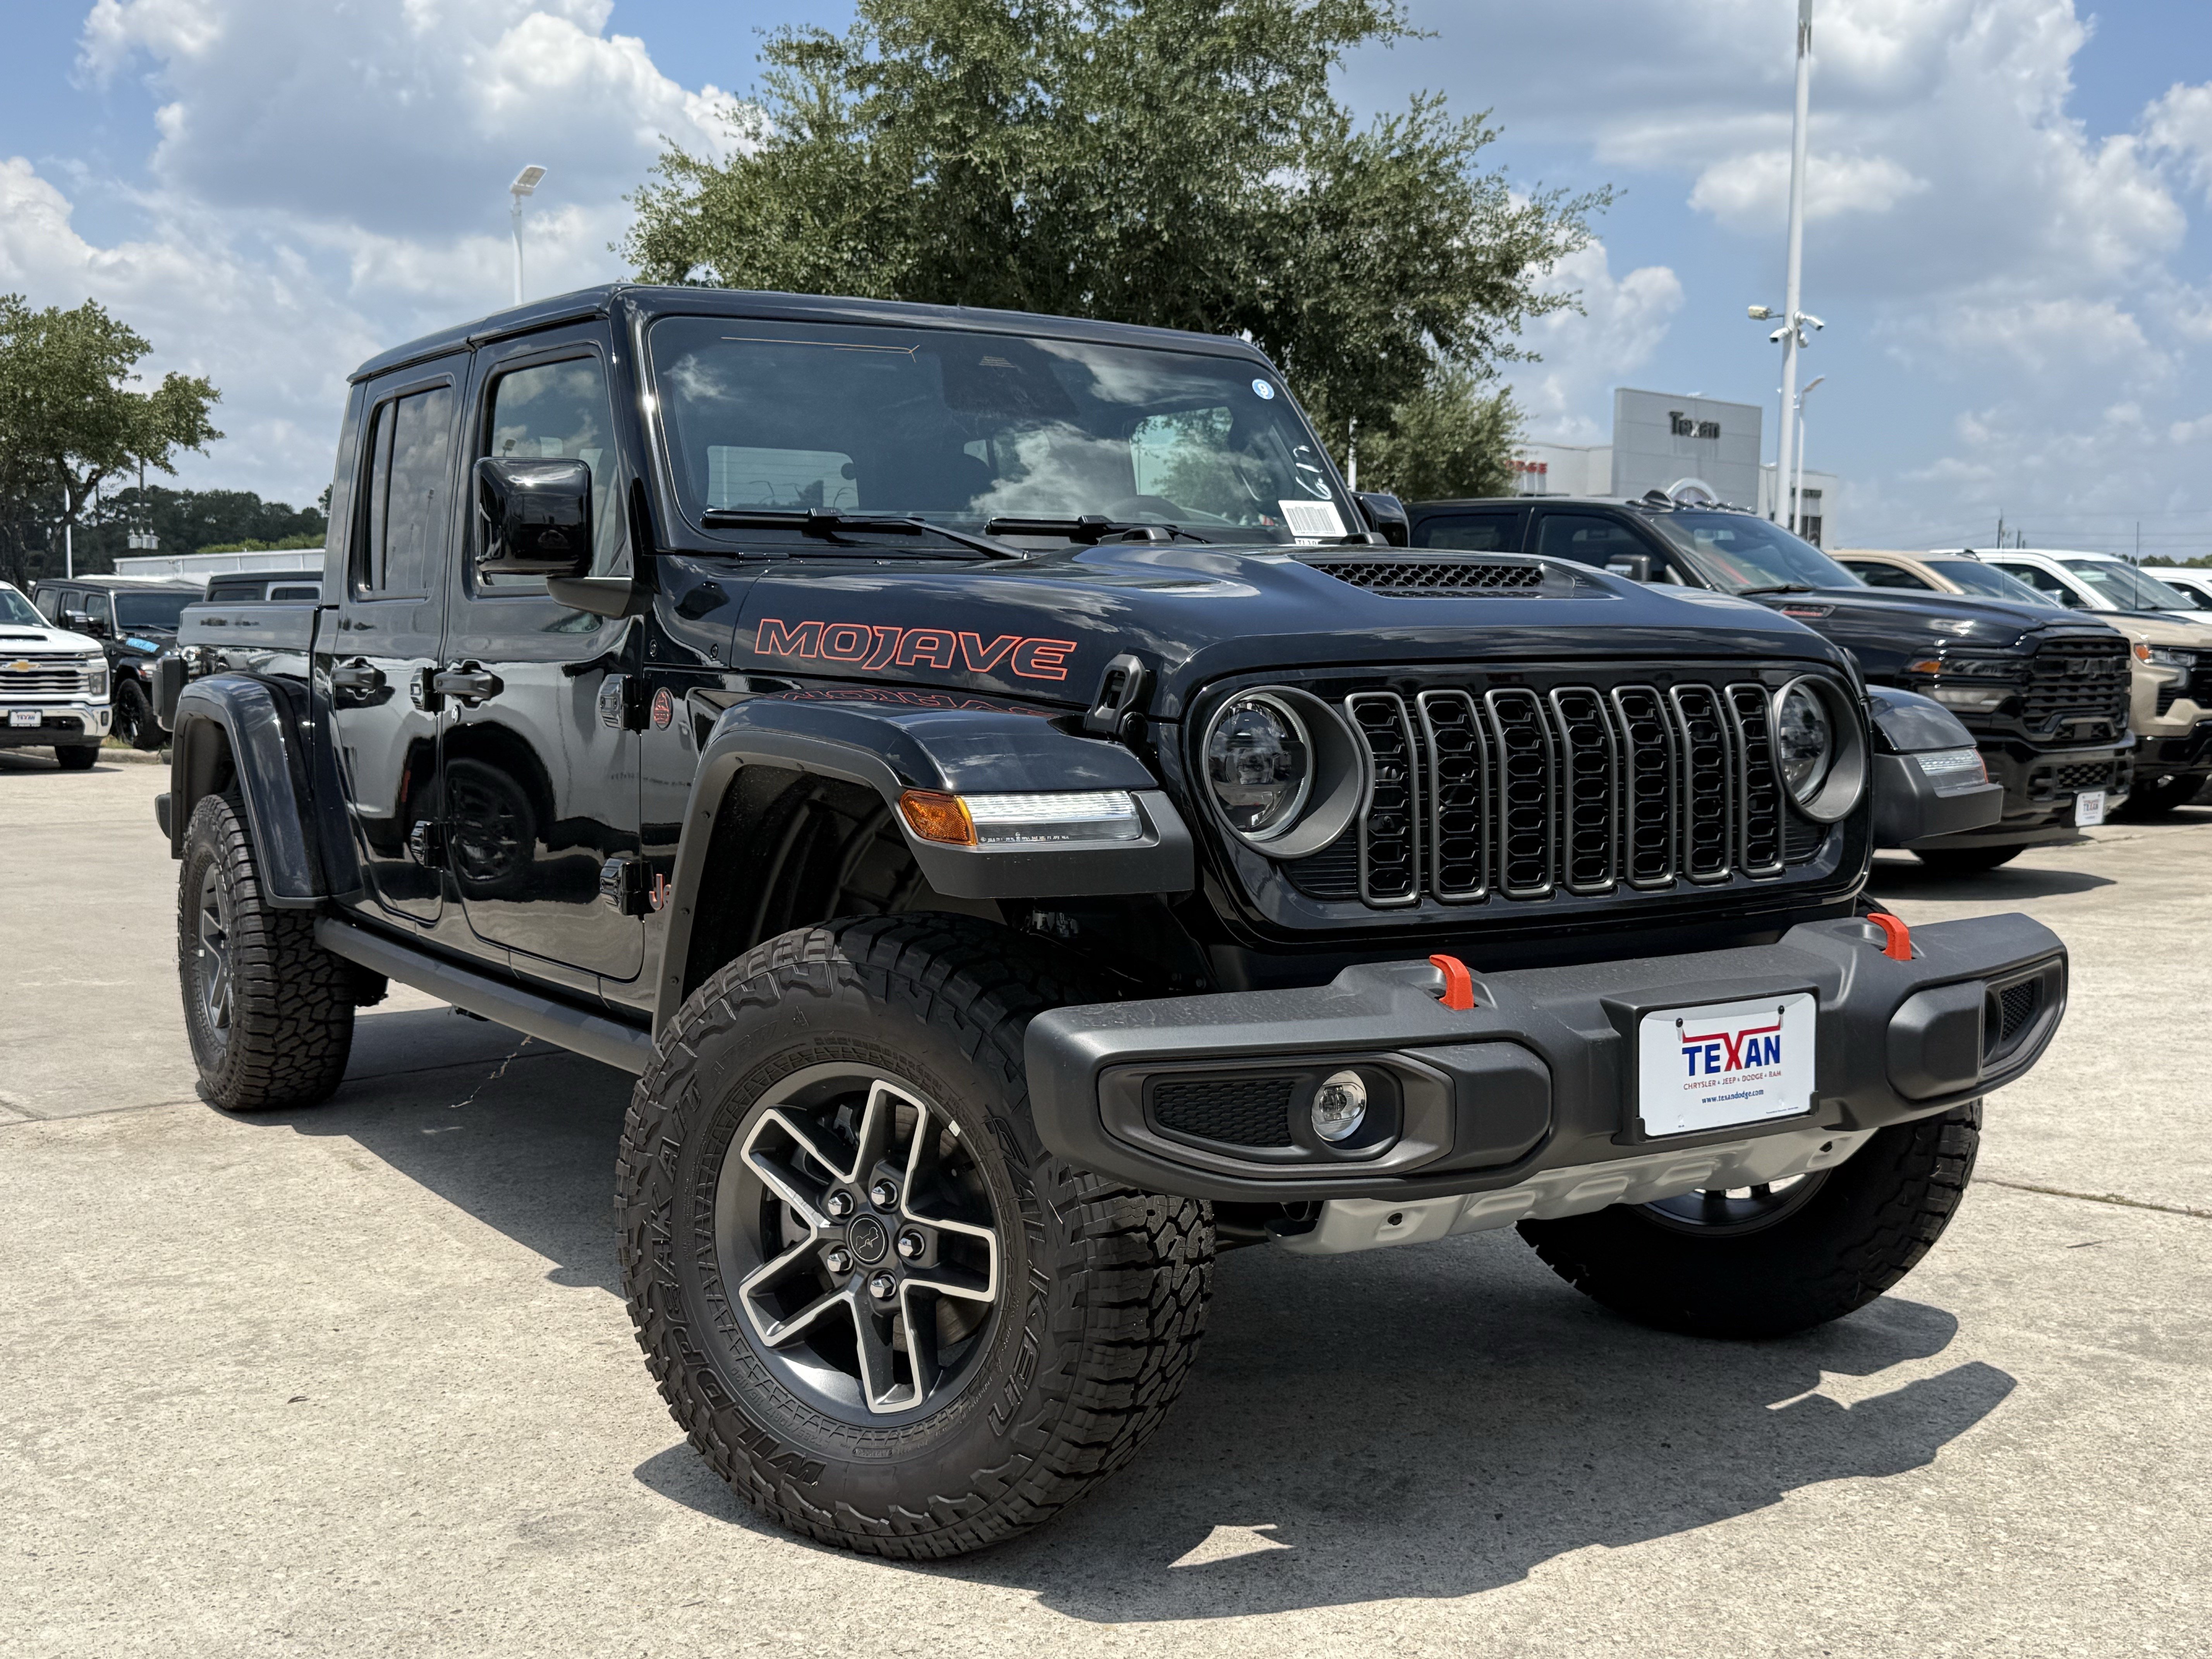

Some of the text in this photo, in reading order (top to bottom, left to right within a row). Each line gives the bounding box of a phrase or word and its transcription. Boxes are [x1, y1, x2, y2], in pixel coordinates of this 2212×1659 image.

[1669, 411, 1720, 440] Texan
[754, 618, 1077, 681] MOJAVE
[1681, 1028, 1781, 1077] TEXAN
[1683, 1079, 1716, 1090] CHRYSLER
[1722, 1076, 1736, 1085] JEEP
[1742, 1072, 1764, 1082] DODGE
[1702, 1089, 1764, 1104] www.texandodge.com
[985, 1115, 1049, 1437] FALKEN
[651, 1181, 827, 1486] WILDPEAK
